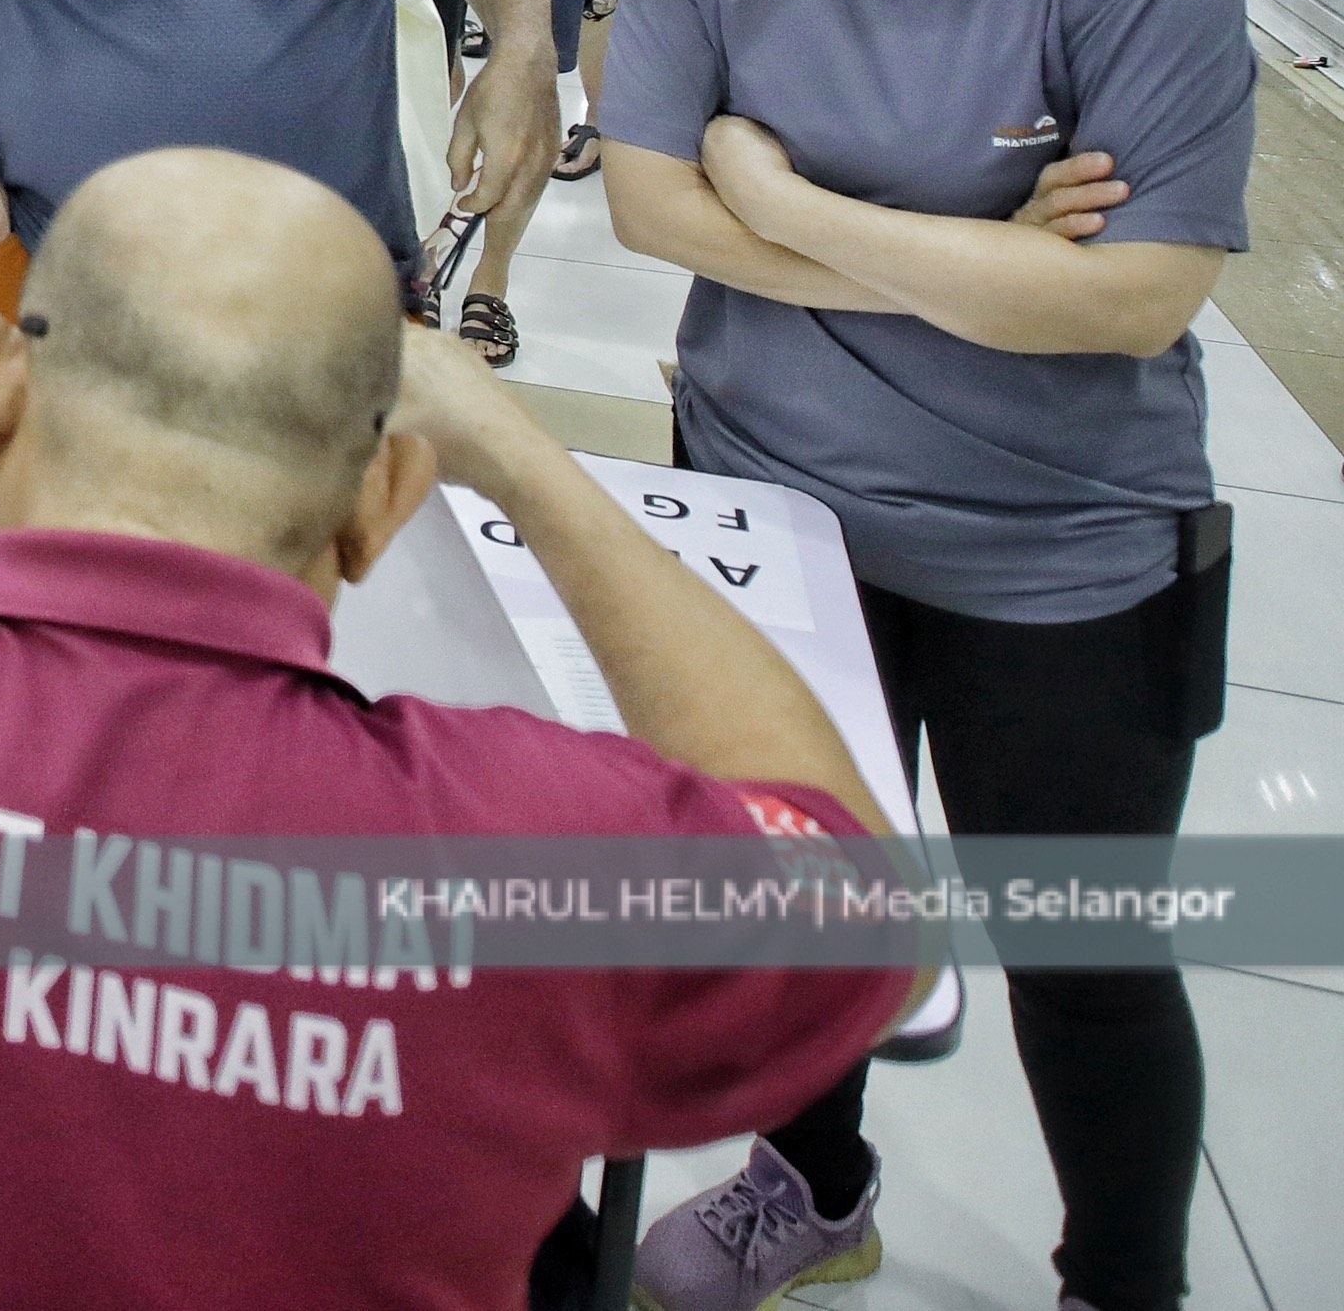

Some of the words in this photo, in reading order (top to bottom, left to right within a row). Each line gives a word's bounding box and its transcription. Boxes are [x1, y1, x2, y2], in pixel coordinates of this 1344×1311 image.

[642, 493, 691, 520] G
[708, 555, 761, 588] A
[67, 827, 476, 992] KHIDMAT
[2, 946, 404, 1118] KINRARA
